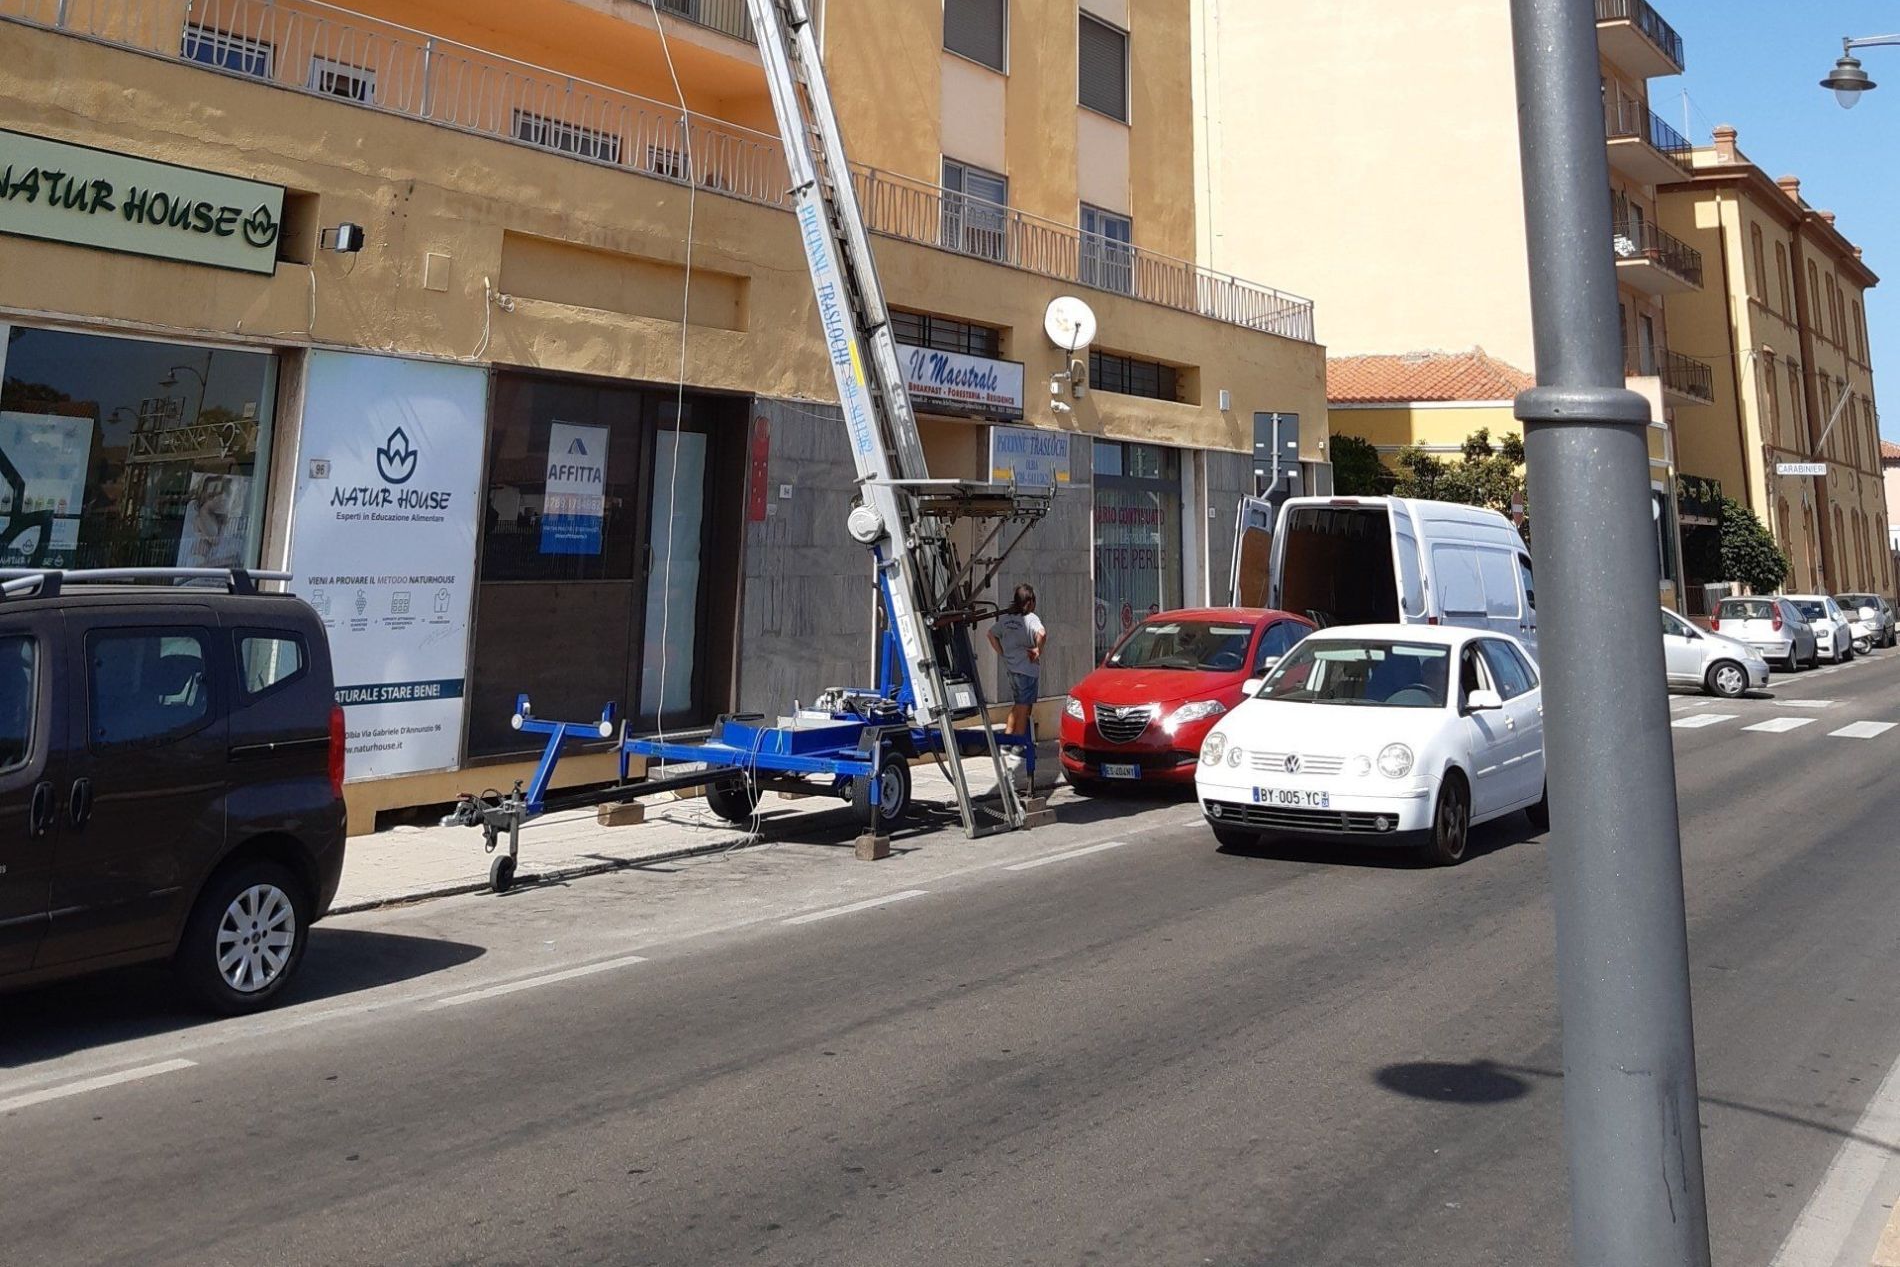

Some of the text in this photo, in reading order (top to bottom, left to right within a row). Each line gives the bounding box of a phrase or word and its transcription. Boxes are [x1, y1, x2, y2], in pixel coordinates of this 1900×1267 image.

[122, 186, 243, 236] HOUSE
[818, 281, 851, 366] TRASLOCHI
[909, 349, 998, 392] Il Maestrale
[908, 382, 942, 394] BREAKFAST
[947, 387, 981, 400] FORESTERIA
[986, 393, 1015, 405] RESIDENCE
[1030, 436, 1068, 457] TRASLOCHI
[315, 464, 325, 475] 96
[548, 464, 602, 483] AFFITTA
[1777, 465, 1826, 473] CARABINIERI
[330, 486, 452, 510] NATUR HOUSE
[336, 512, 361, 521] Esperti
[371, 513, 409, 521] Educazione
[411, 514, 444, 522] Alimentare
[1104, 548, 1129, 569] TRE
[1131, 548, 1167, 570] PERLE
[308, 575, 456, 584] VIENI A PROVARE IL METODO NATURHOUSE
[334, 684, 441, 703] ATURALE STARE BENE!
[373, 727, 399, 737] Gabriele
[434, 724, 442, 732] 96
[345, 741, 403, 754] w.naturhouse.it
